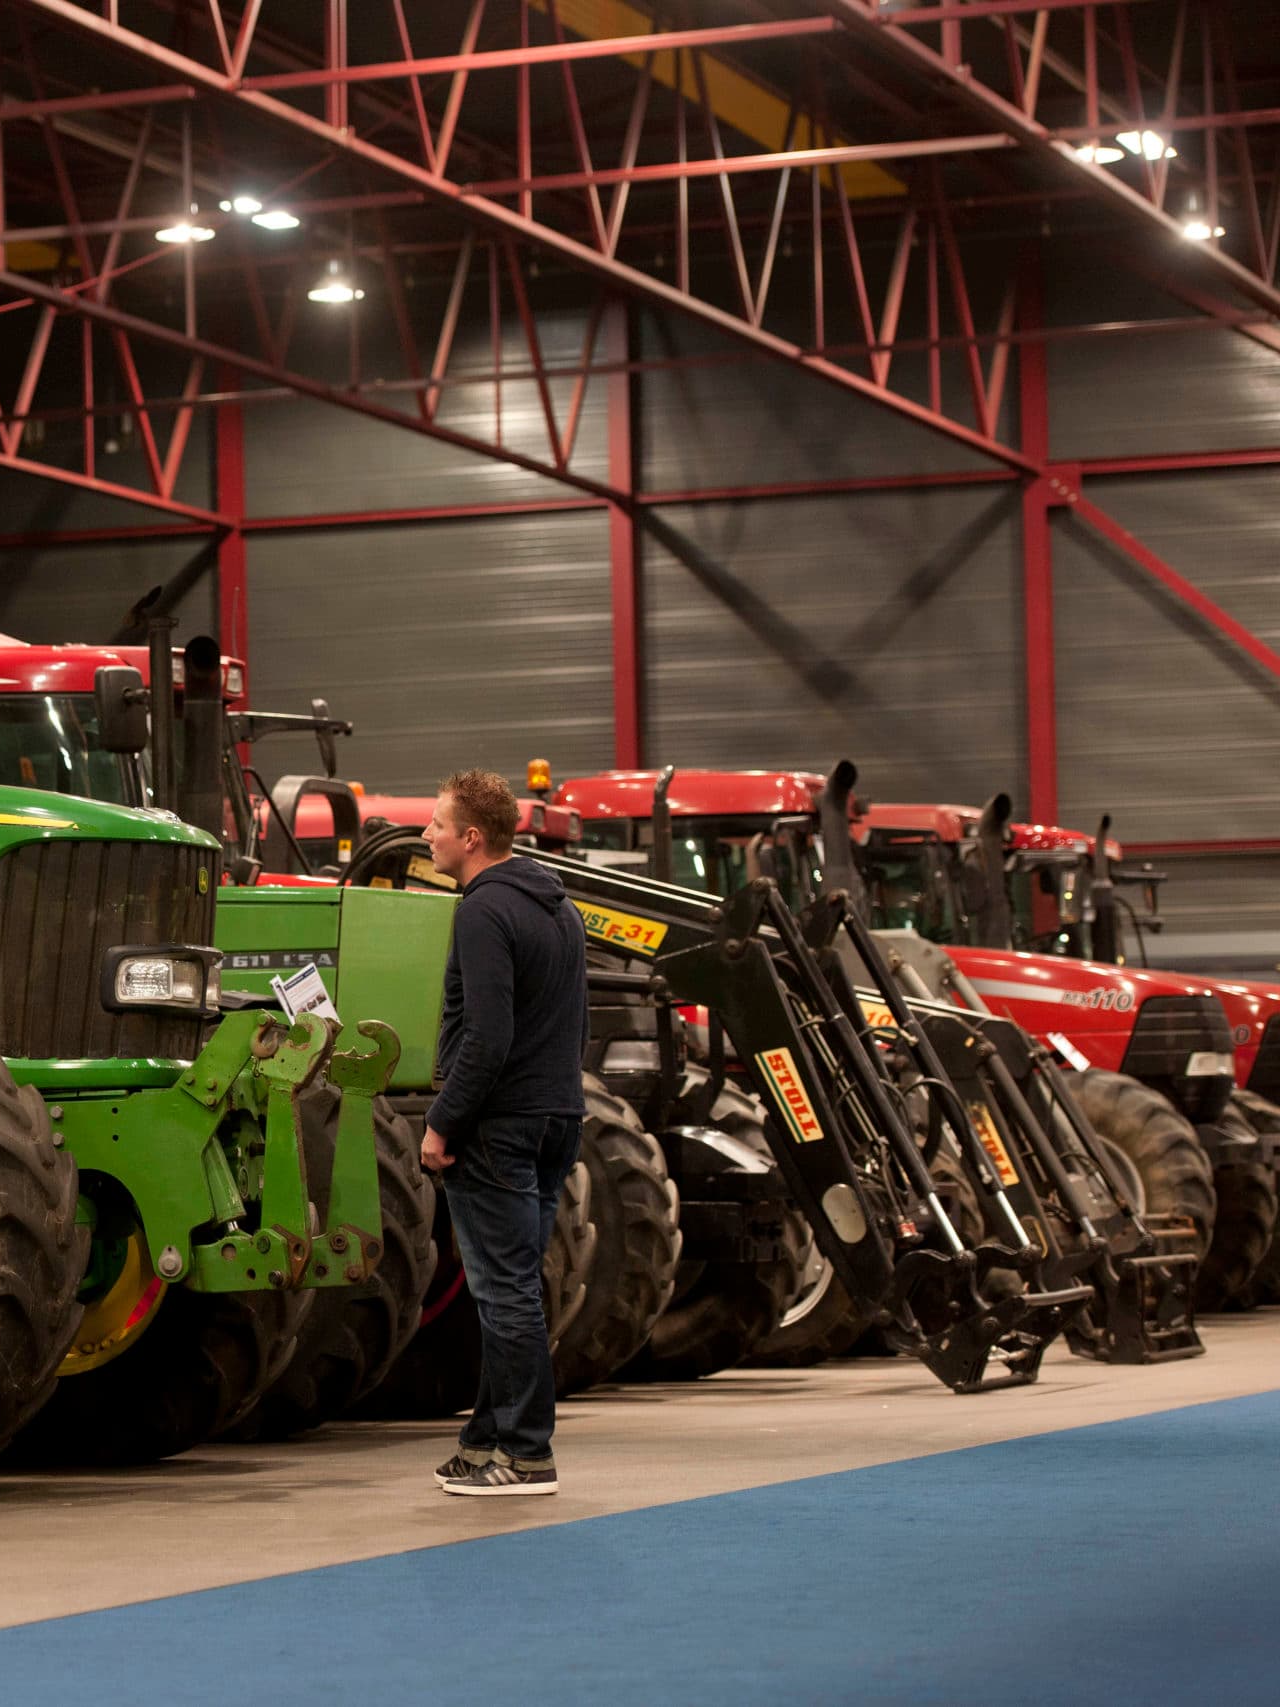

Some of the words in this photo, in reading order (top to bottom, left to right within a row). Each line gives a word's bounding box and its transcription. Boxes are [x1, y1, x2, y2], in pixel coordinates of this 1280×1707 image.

[581, 909, 610, 929] UST
[232, 955, 270, 968] 611
[767, 1054, 817, 1136] STOLL
